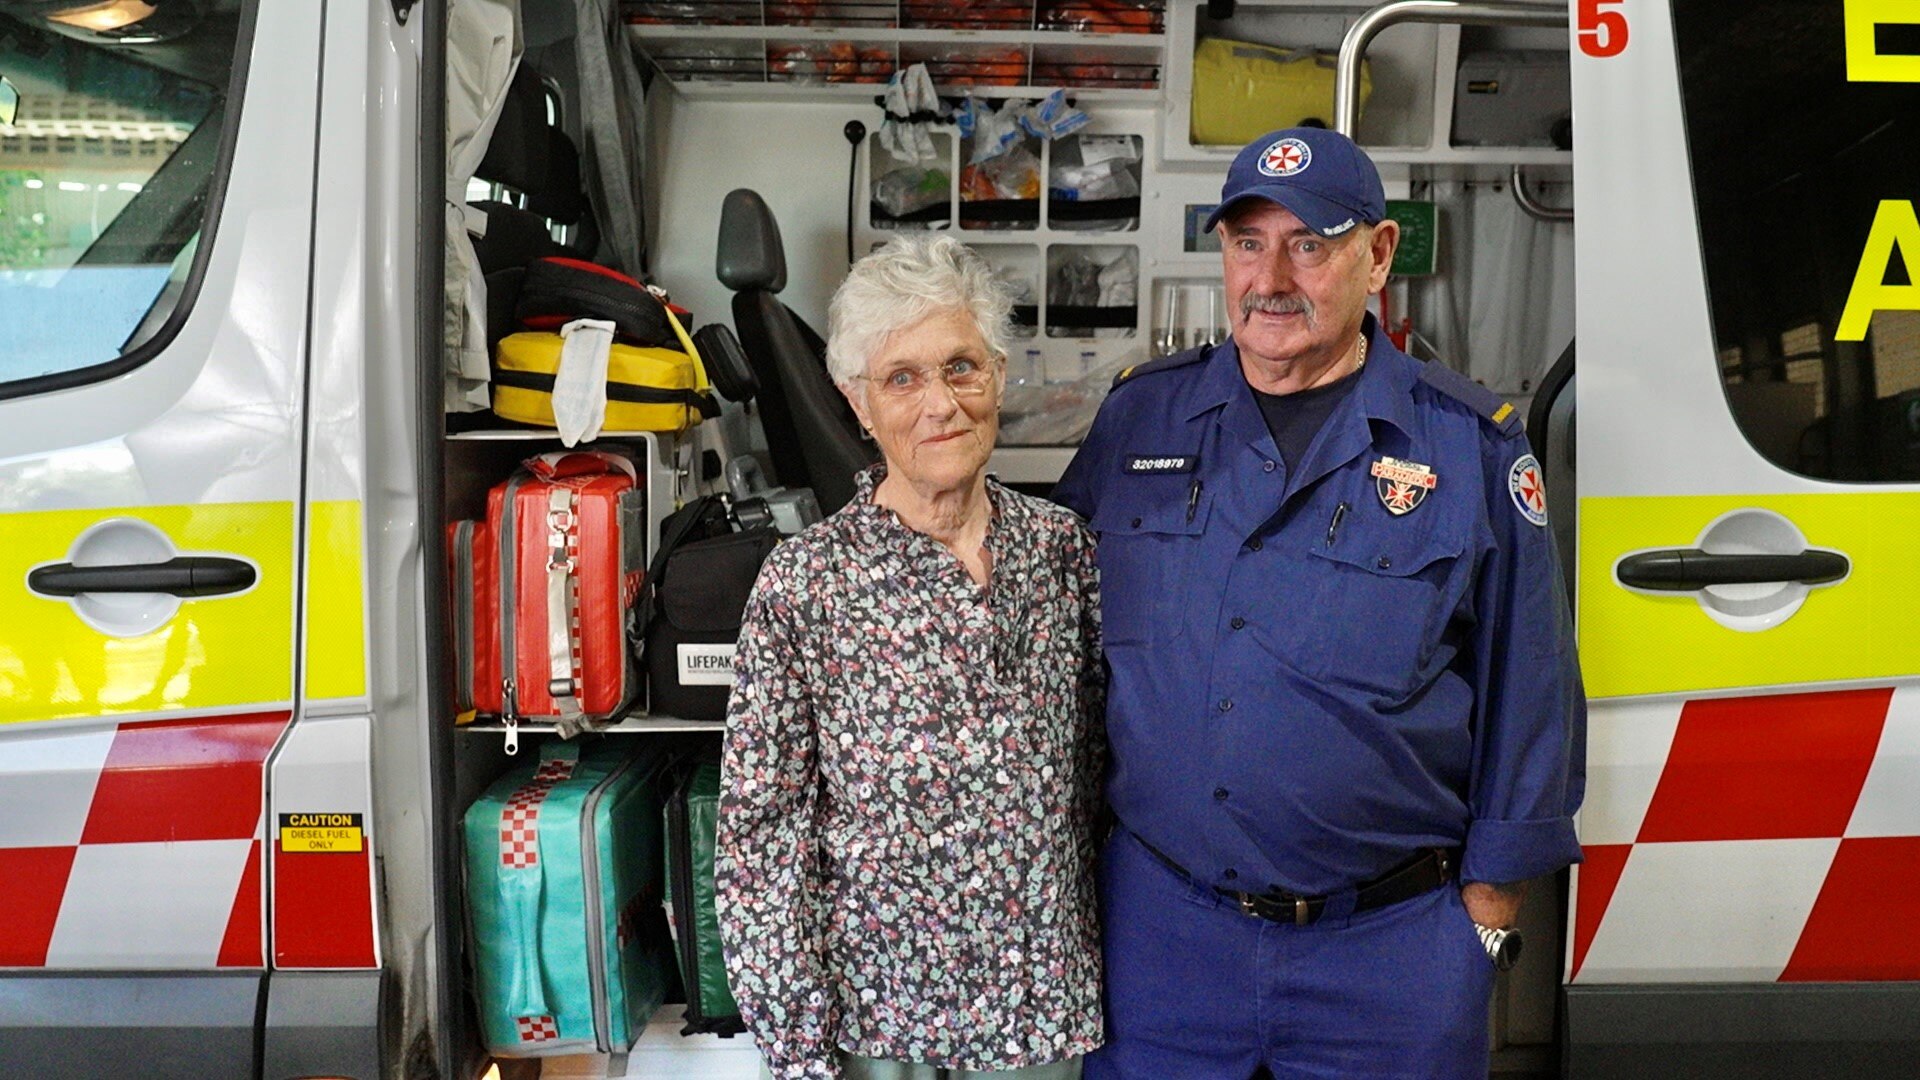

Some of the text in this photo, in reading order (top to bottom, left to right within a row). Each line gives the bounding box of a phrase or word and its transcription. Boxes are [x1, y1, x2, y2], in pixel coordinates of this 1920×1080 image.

[1578, 0, 1629, 58] 5
[1132, 458, 1185, 470] 32018979
[687, 655, 732, 669] LIFEPAK
[289, 814, 352, 826] CAUTION
[291, 830, 351, 839] DIESEL FUEL
[309, 840, 334, 849] ONLY
